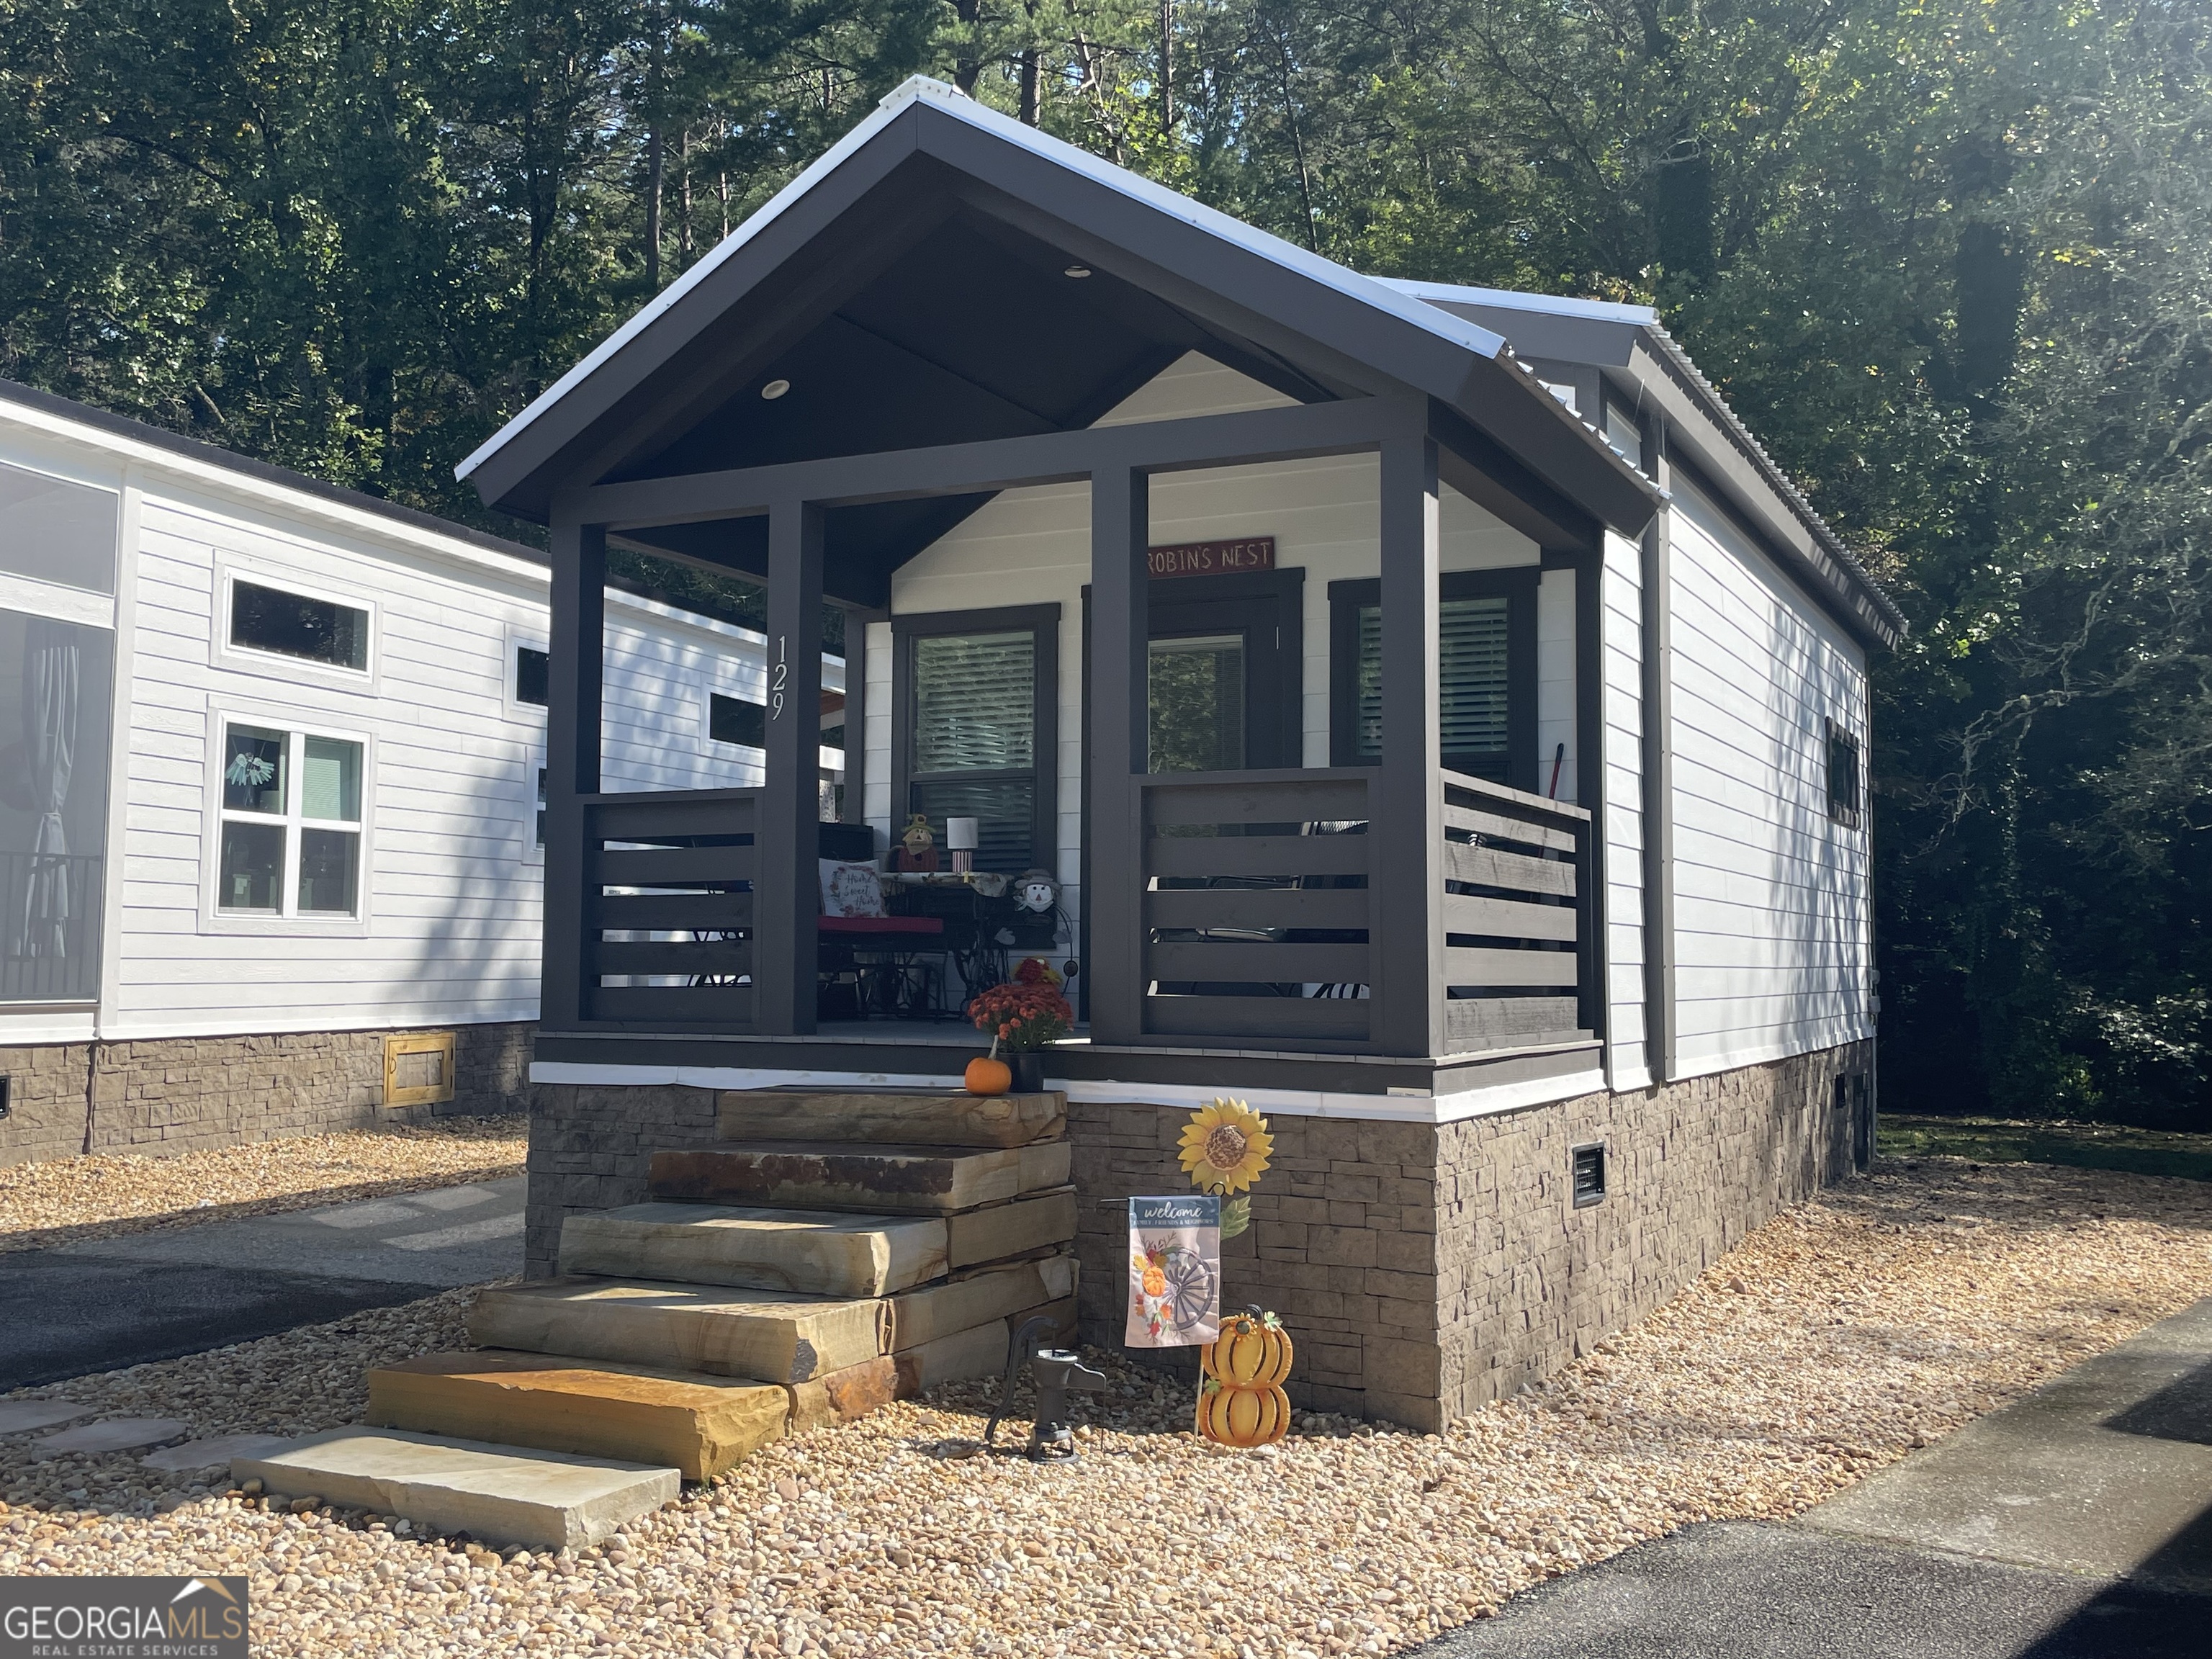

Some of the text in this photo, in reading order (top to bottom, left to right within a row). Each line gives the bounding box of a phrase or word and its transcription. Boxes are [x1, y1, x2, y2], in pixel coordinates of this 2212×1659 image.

[1222, 542, 1271, 567] NEST
[773, 635, 787, 721] 129
[1144, 1201, 1202, 1218] welcome
